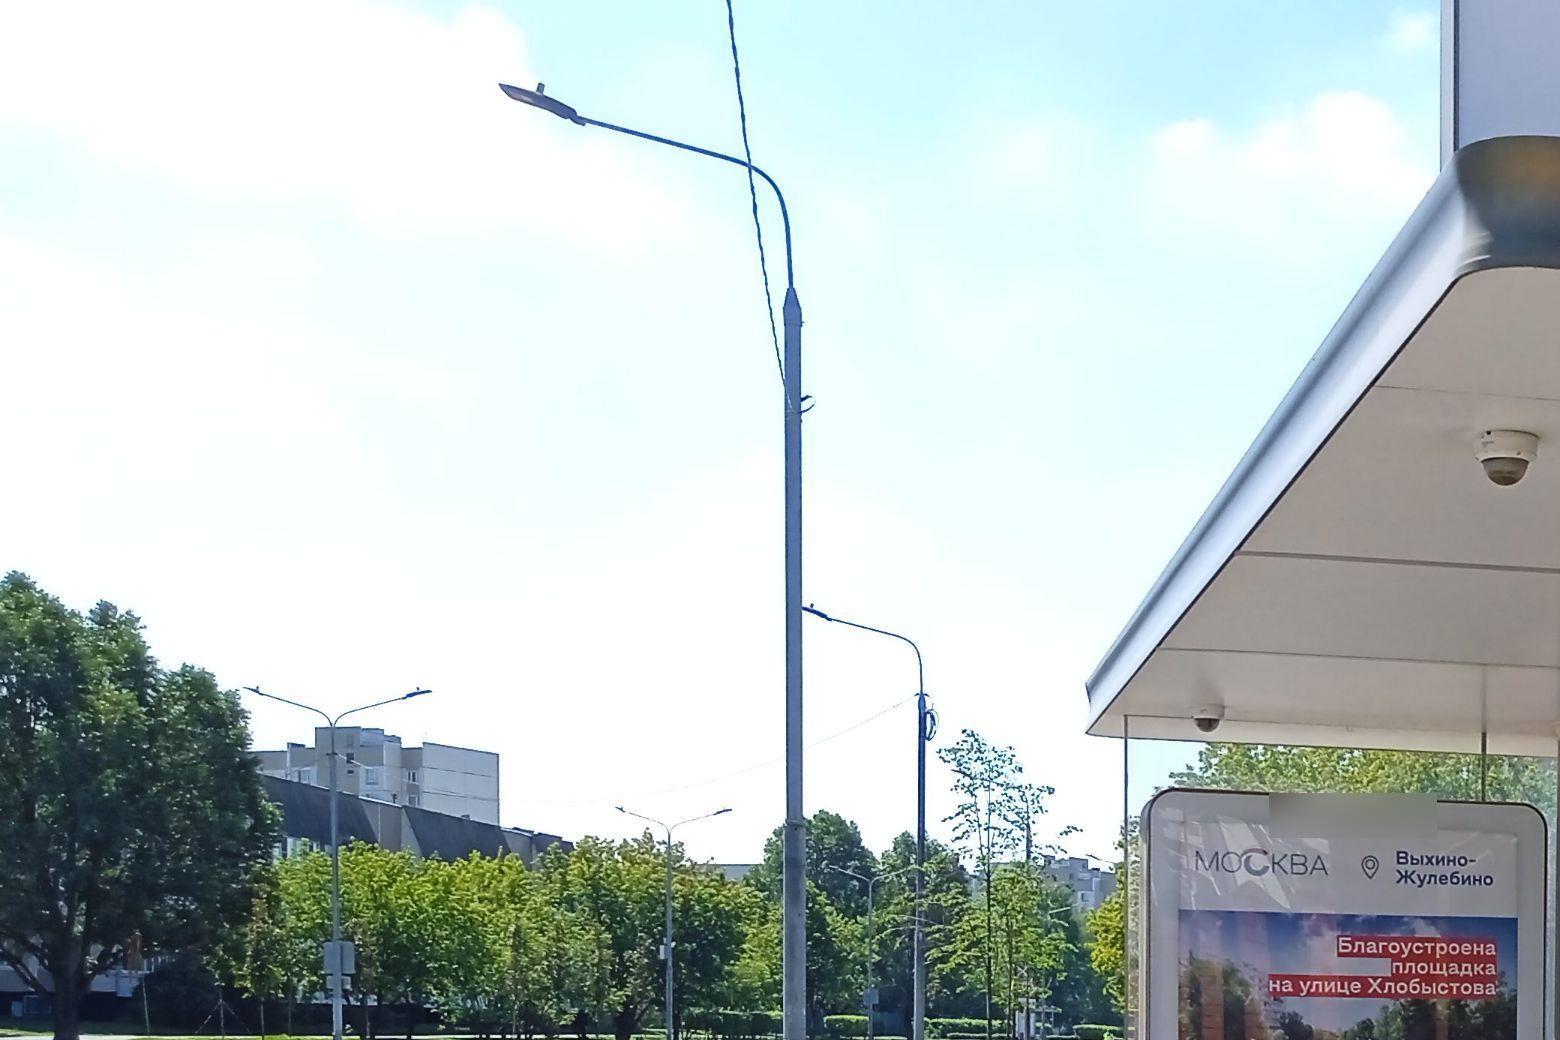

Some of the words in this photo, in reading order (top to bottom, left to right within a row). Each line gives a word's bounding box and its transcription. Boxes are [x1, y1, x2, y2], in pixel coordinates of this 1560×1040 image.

[1194, 847, 1329, 877] МОСКВА
[1396, 850, 1476, 868] Выхино-
[1396, 870, 1494, 888] Жулебино
[1338, 937, 1496, 958] Благоустроена
[1392, 961, 1496, 976] площадка
[1269, 980, 1293, 992] на
[1300, 981, 1361, 996] улице
[1368, 978, 1496, 995] Хлобыстова
